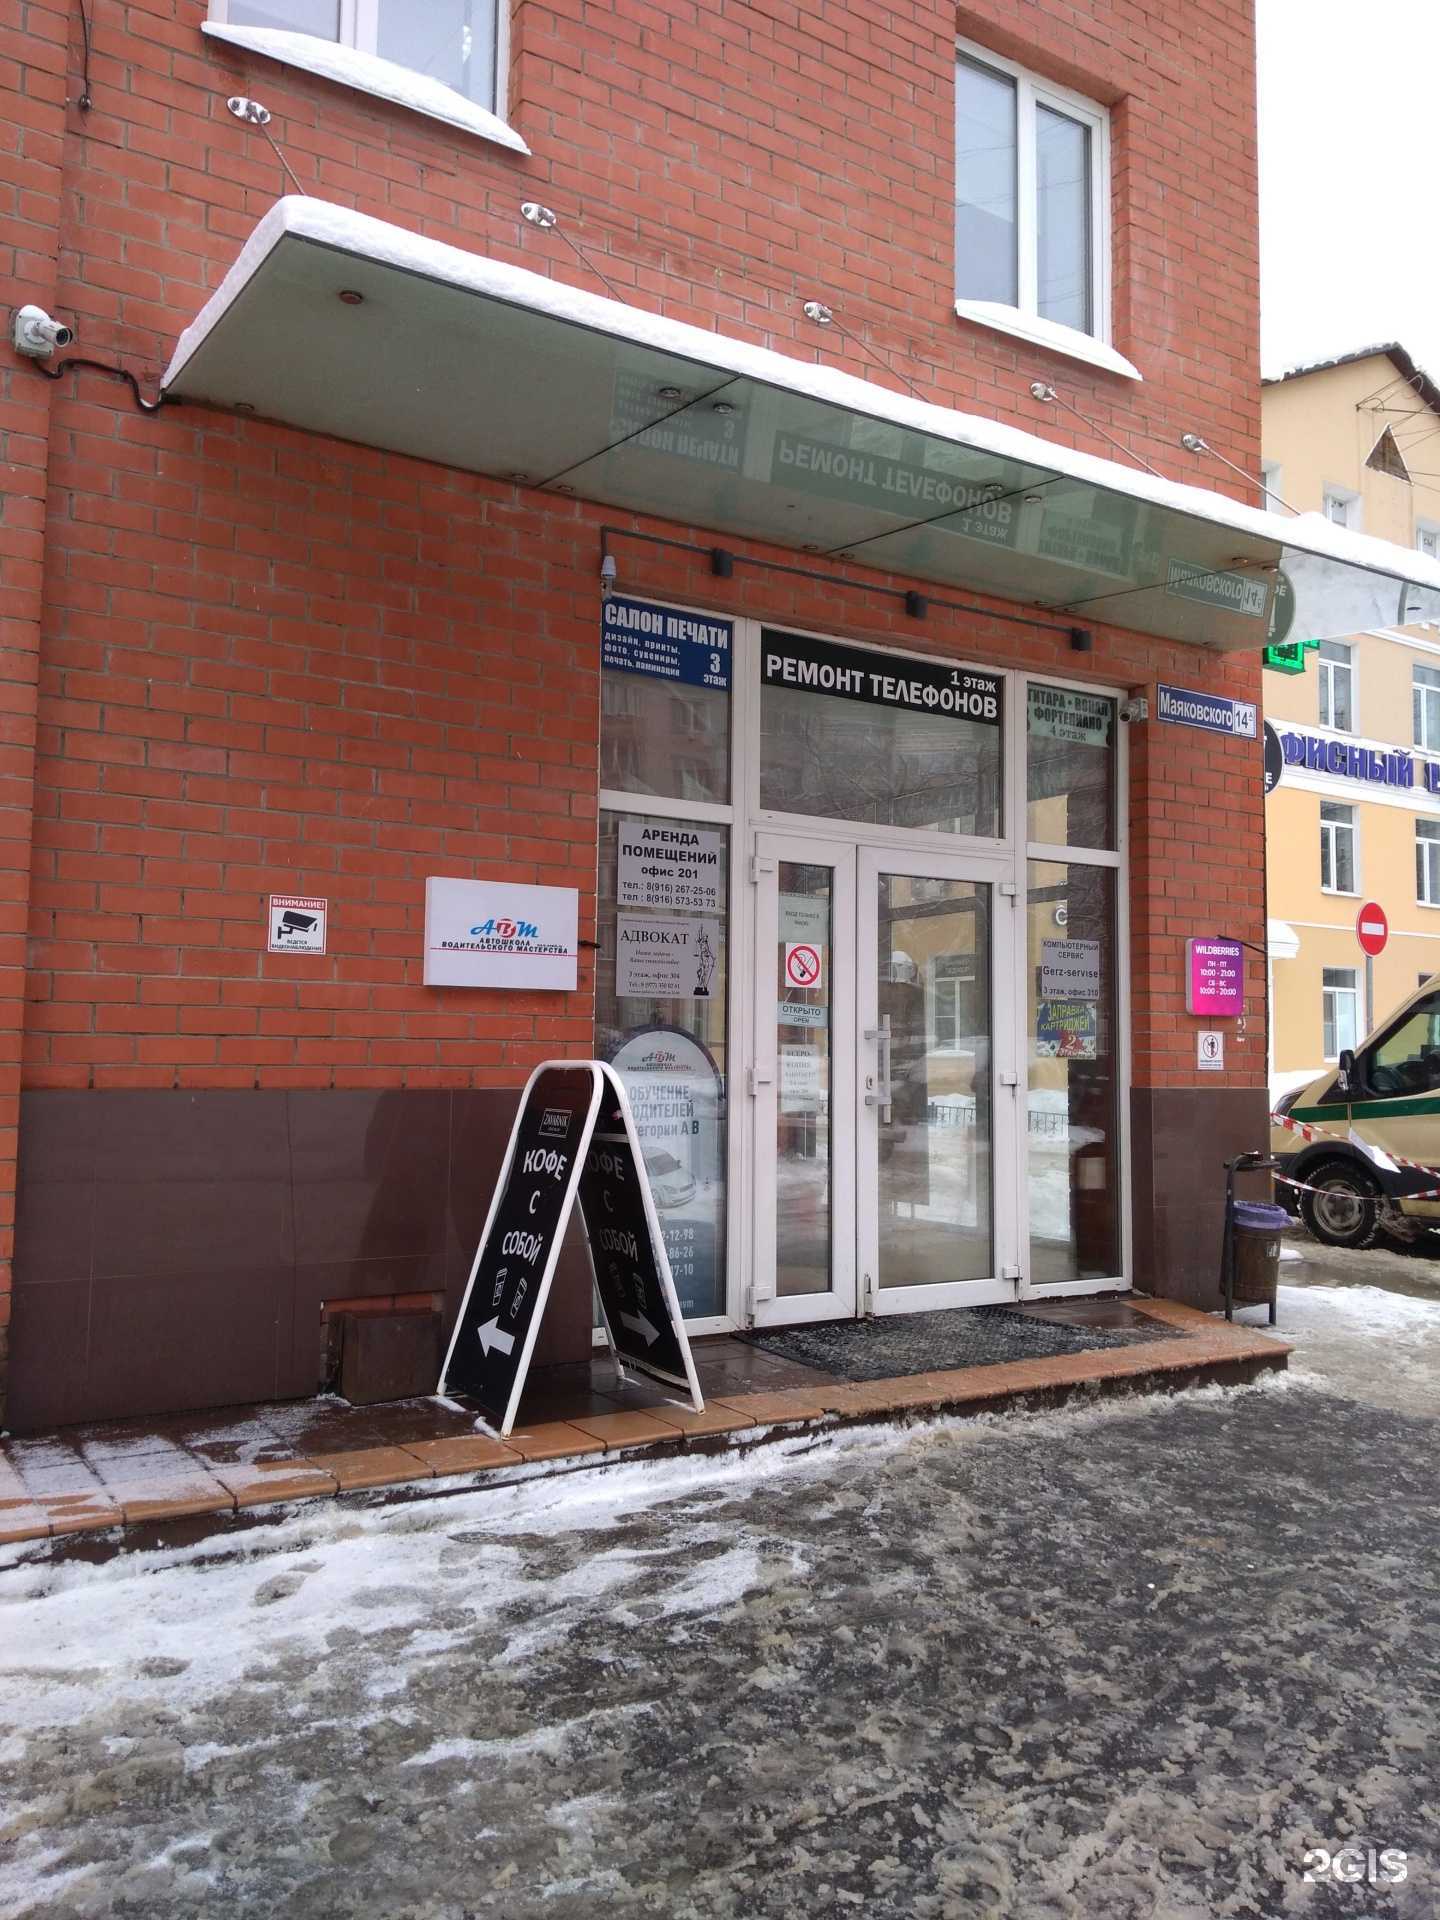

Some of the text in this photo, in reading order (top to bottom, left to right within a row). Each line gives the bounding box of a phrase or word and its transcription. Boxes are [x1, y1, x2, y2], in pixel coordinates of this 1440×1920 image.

[605, 603, 728, 649] САЛОН ПЕЧАТИ
[605, 632, 641, 647] дизайн,
[636, 661, 680, 676] ламинация
[710, 653, 720, 673] 3
[704, 674, 727, 686] этаж
[767, 654, 997, 719] РЕМОНТ ТЕЛЕФОНОВ
[950, 671, 996, 692] 1 этаж
[1028, 689, 1109, 716] ГИТАРА ВОКАЛ
[1160, 691, 1232, 726] Маяковского
[1034, 707, 1102, 731] ФОРТЕПИАНО
[1049, 725, 1086, 741] 4 этаж
[1280, 732, 1414, 788] ФИСНЫЙ
[642, 828, 699, 846] АРЕНДА
[623, 844, 717, 865] ПОМЕЩЕНИЙ
[641, 866, 698, 879] офис 201
[646, 882, 673, 894] 8(916)
[676, 885, 716, 896] 267-25-06
[272, 898, 324, 909] ВНИМАНИЕ!
[646, 894, 673, 905] 8(916)
[480, 937, 530, 947] АВТОШКОЛА
[621, 930, 689, 945] АДВОКАТ
[442, 941, 567, 954] ВОДИТЕЛЬСКОГО МАСТЕРСТВА
[1043, 941, 1098, 951] КОМПЬЮТЕРНЫЙ
[1195, 945, 1239, 957] WILDBERRIES
[1058, 951, 1084, 960] СЕРВИС
[1043, 965, 1098, 978] Gerz-servise
[1200, 969, 1216, 977] 10:00
[1221, 969, 1235, 977] 21:00
[1200, 987, 1216, 995] 10:00
[1220, 987, 1236, 996] 20:00
[782, 1005, 820, 1017] ОТКРЫТО
[1065, 1034, 1077, 1050] 2
[630, 1085, 689, 1101] ОБУЧЕНИЕ
[633, 1099, 694, 1121] ОДИТЕЛЕЙ
[636, 1120, 699, 1140] тегории А В
[523, 1149, 567, 1181] КОФЕ
[587, 1151, 625, 1182] ОФЕ
[529, 1190, 541, 1214] С
[661, 1228, 694, 1241] 2-12-98
[502, 1230, 543, 1267] СОБОЙ
[600, 1229, 639, 1262] СОБОЙ
